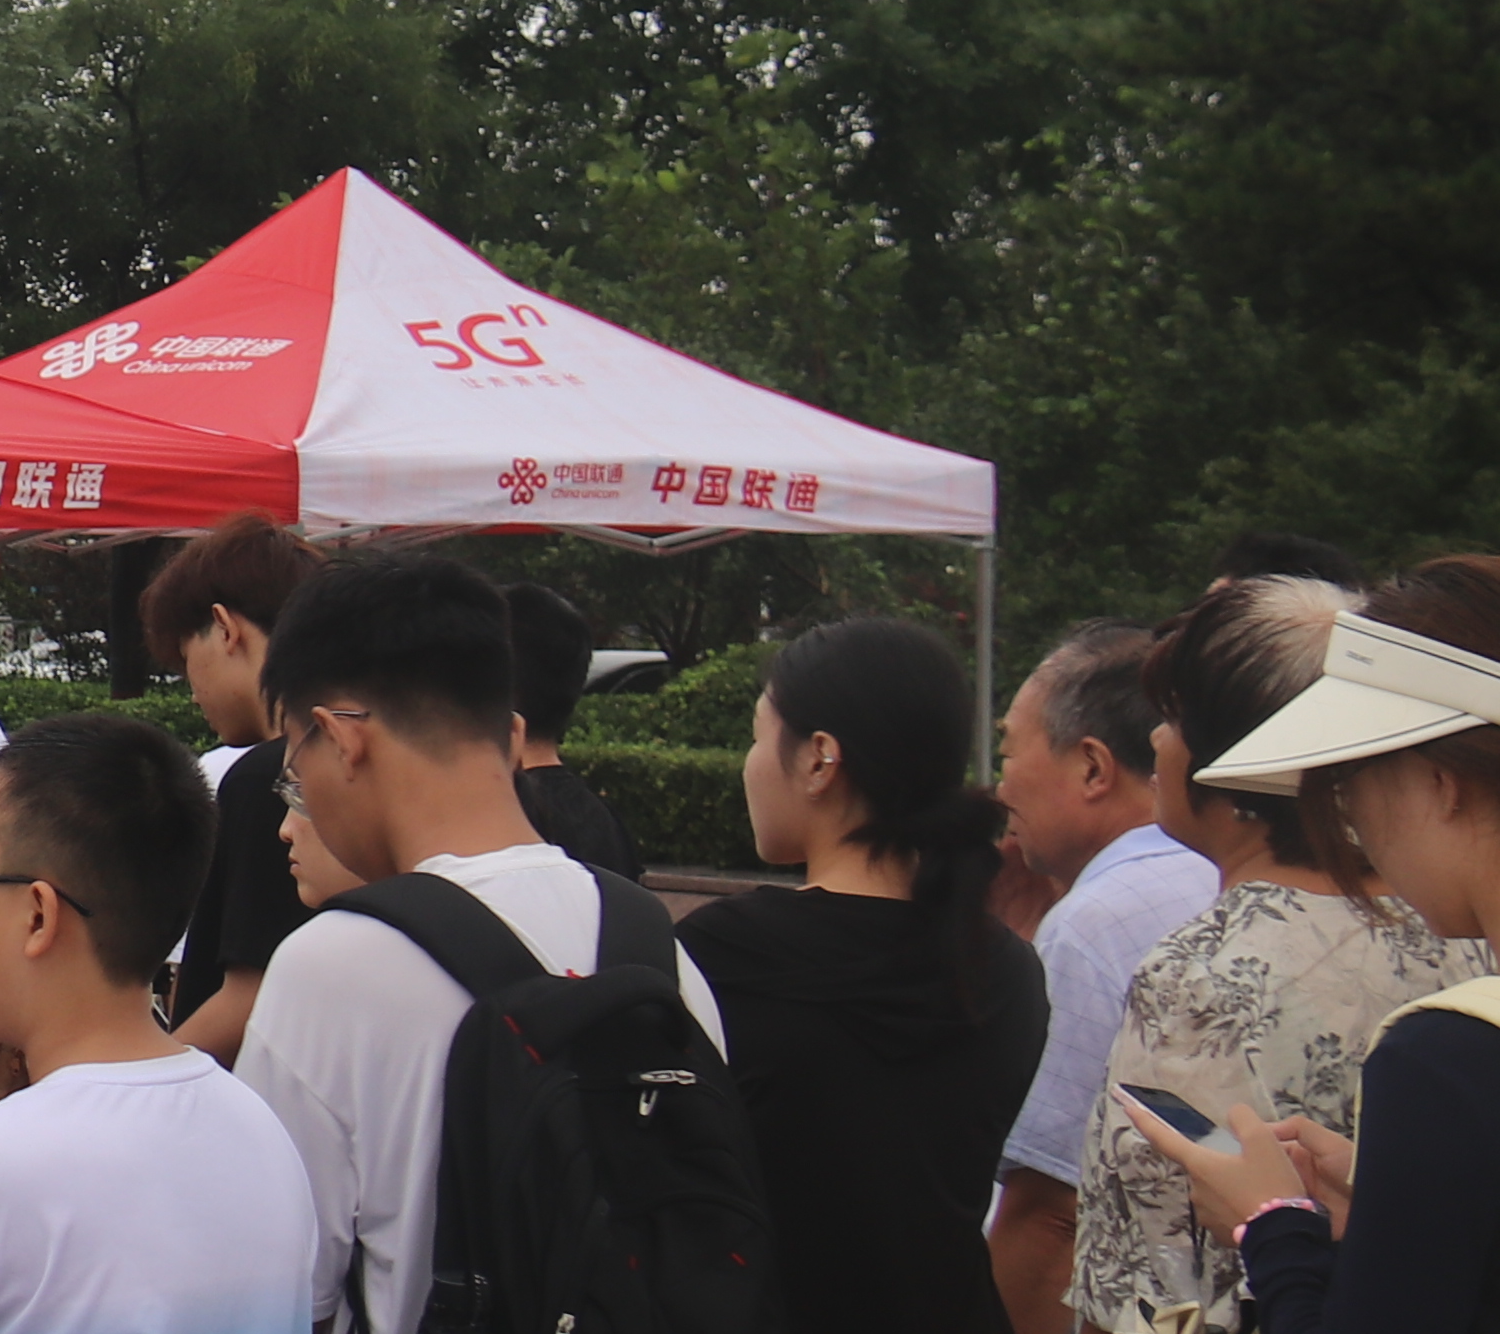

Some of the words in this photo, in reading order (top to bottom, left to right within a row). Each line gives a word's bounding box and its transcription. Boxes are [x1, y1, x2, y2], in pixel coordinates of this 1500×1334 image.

[149, 335, 293, 358] 中国联通
[122, 359, 178, 375] China
[178, 360, 254, 373] unicom
[553, 463, 624, 484] 中国联通
[651, 461, 819, 513] 中国联通
